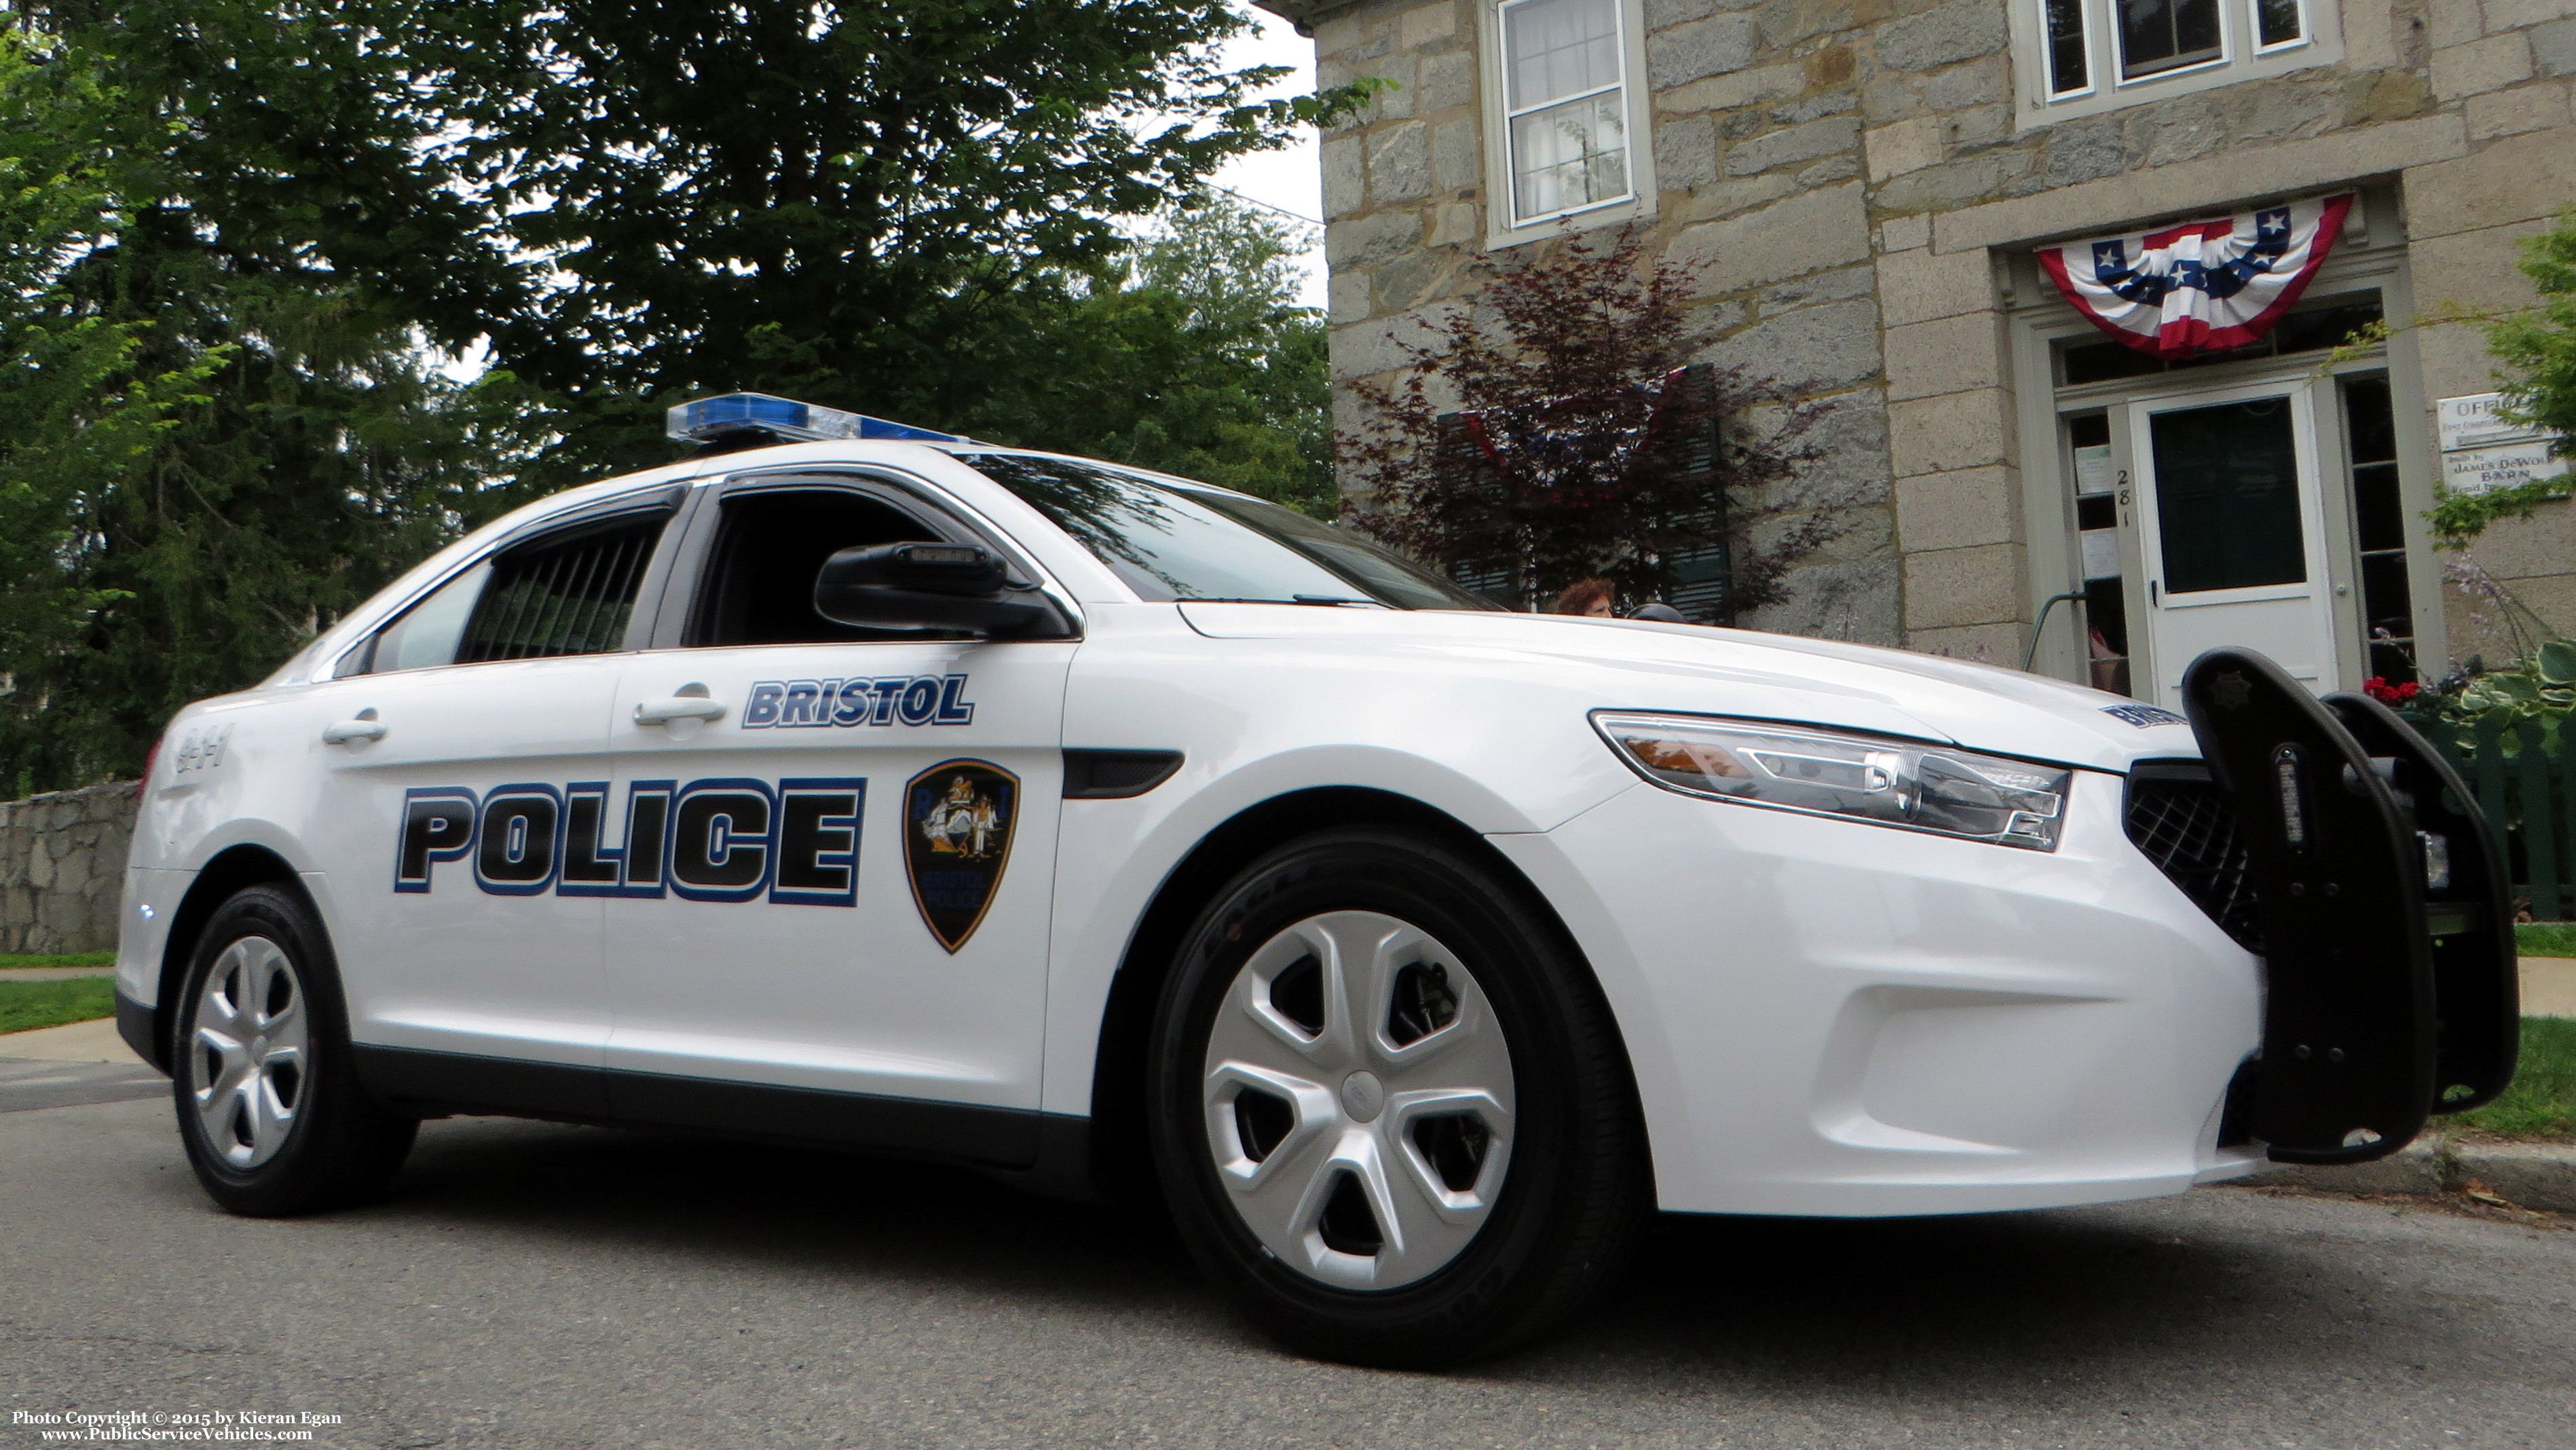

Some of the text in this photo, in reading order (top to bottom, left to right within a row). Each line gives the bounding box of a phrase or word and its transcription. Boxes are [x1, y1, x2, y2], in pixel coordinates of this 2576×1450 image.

[2454, 462, 2496, 474] JAMES
[2482, 470, 2531, 483] BARN
[2117, 470, 2131, 527] 281
[741, 673, 976, 729] BRISTOL
[913, 785, 1009, 821] R I
[394, 776, 868, 908] POLICE
[922, 871, 987, 888] BRISTOL
[926, 891, 982, 908] POLICE
